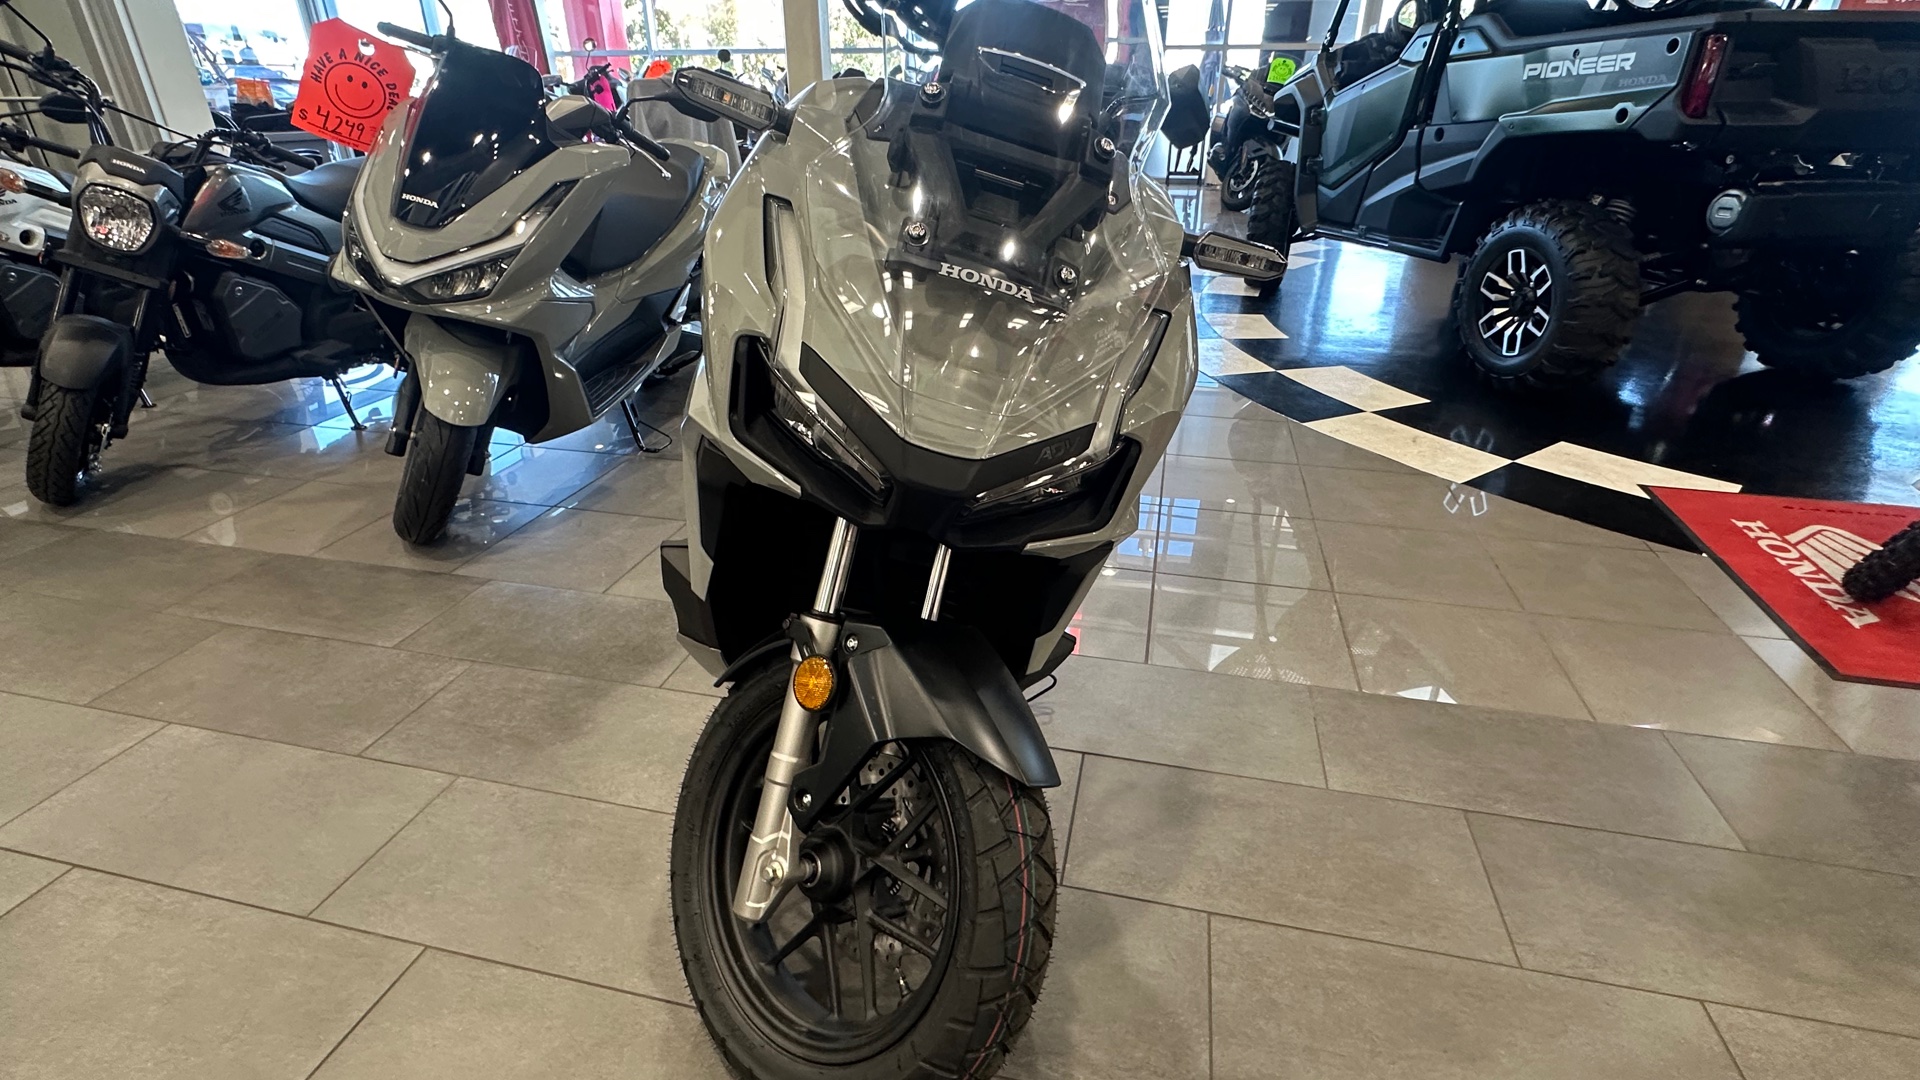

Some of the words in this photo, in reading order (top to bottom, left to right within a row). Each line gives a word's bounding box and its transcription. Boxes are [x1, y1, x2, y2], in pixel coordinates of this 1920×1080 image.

[310, 51, 334, 84] HAVE
[338, 47, 348, 60] A
[353, 51, 389, 78] NICE
[1522, 52, 1636, 81] PIONEER
[1617, 74, 1668, 88] HONDA
[112, 158, 146, 174] HONDA
[401, 193, 439, 209] HONDA
[938, 262, 1035, 304] HONDA
[1730, 518, 1881, 630] HONDA
